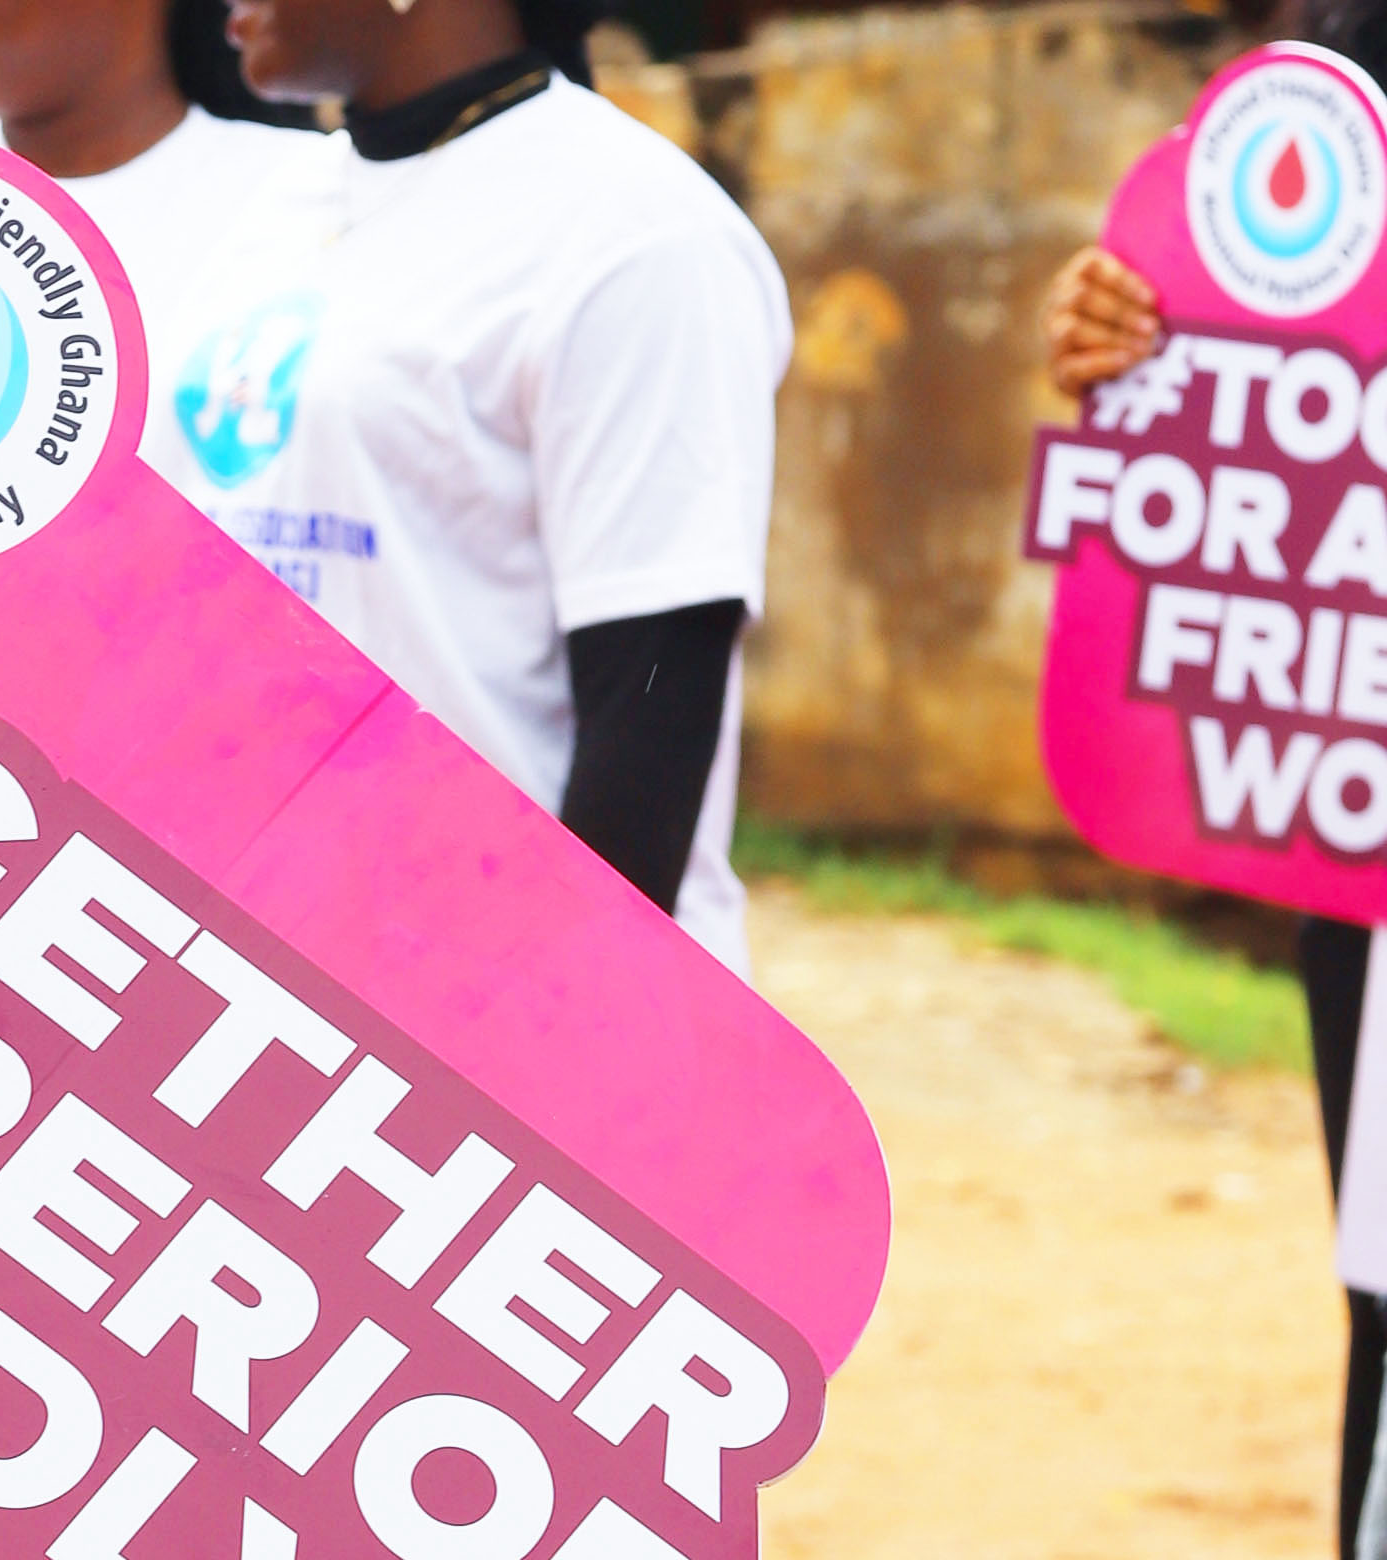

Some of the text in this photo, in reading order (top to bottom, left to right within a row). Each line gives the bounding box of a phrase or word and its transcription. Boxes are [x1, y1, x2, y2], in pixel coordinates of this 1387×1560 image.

[34, 333, 104, 467] Ghana
[1036, 441, 1387, 598] FOR A
[1137, 582, 1387, 727] FRIE
[1189, 715, 1387, 852] WO
